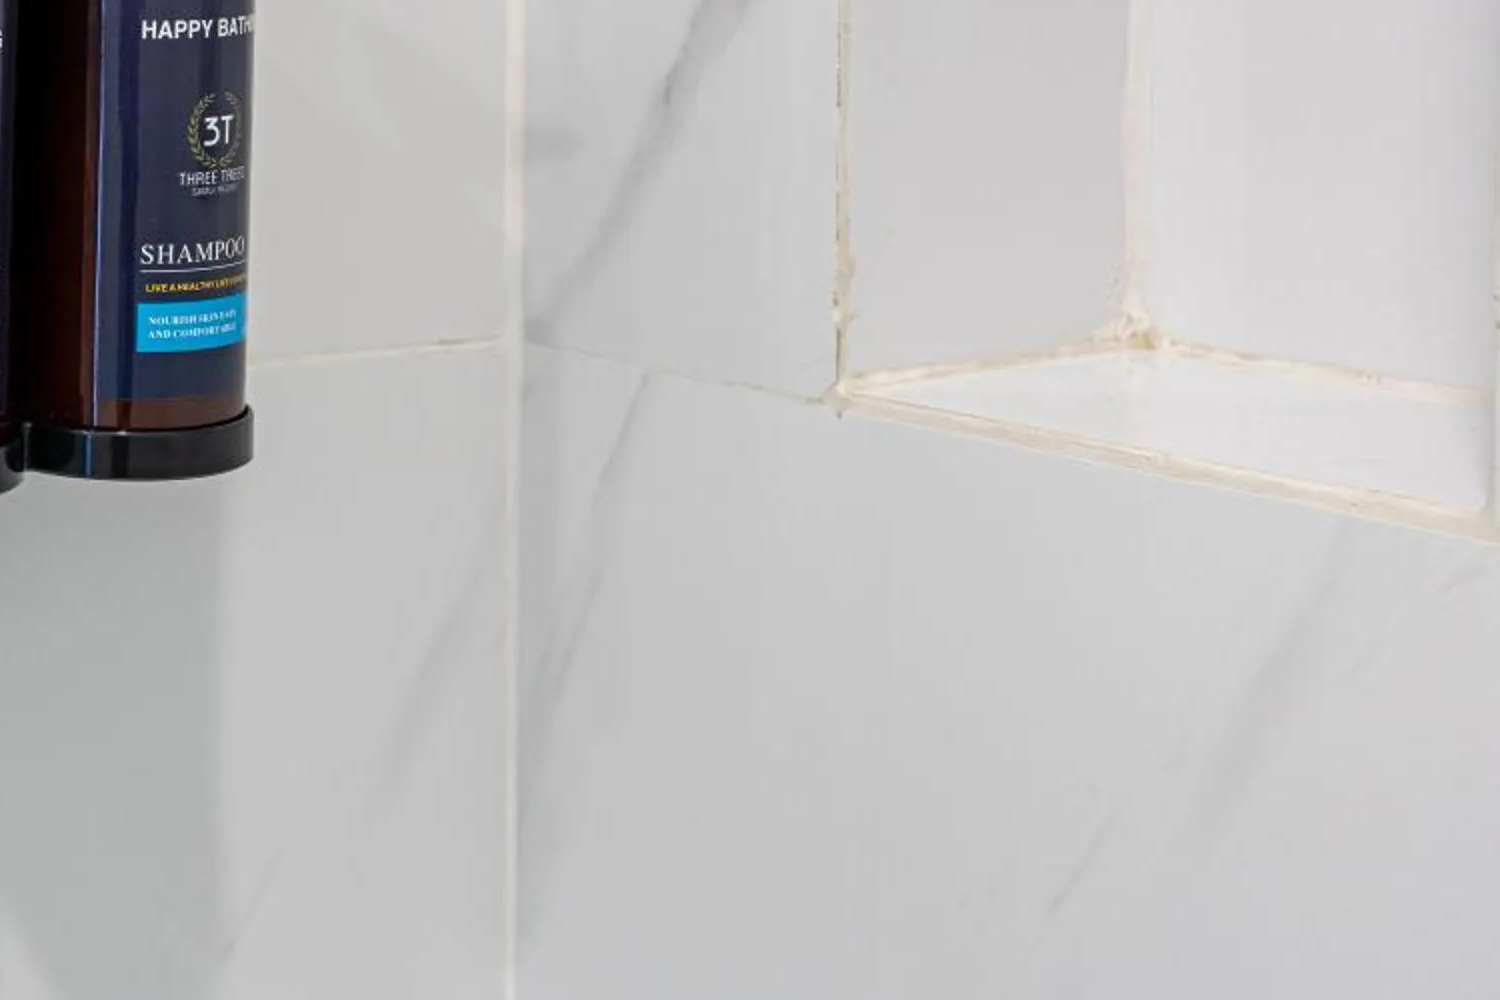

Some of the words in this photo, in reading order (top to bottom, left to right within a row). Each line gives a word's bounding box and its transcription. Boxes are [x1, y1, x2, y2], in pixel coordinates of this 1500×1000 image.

[141, 19, 213, 40] HAPPY
[203, 114, 235, 147] 3T
[179, 170, 217, 186] THREE
[139, 235, 245, 266] SHAMPOO
